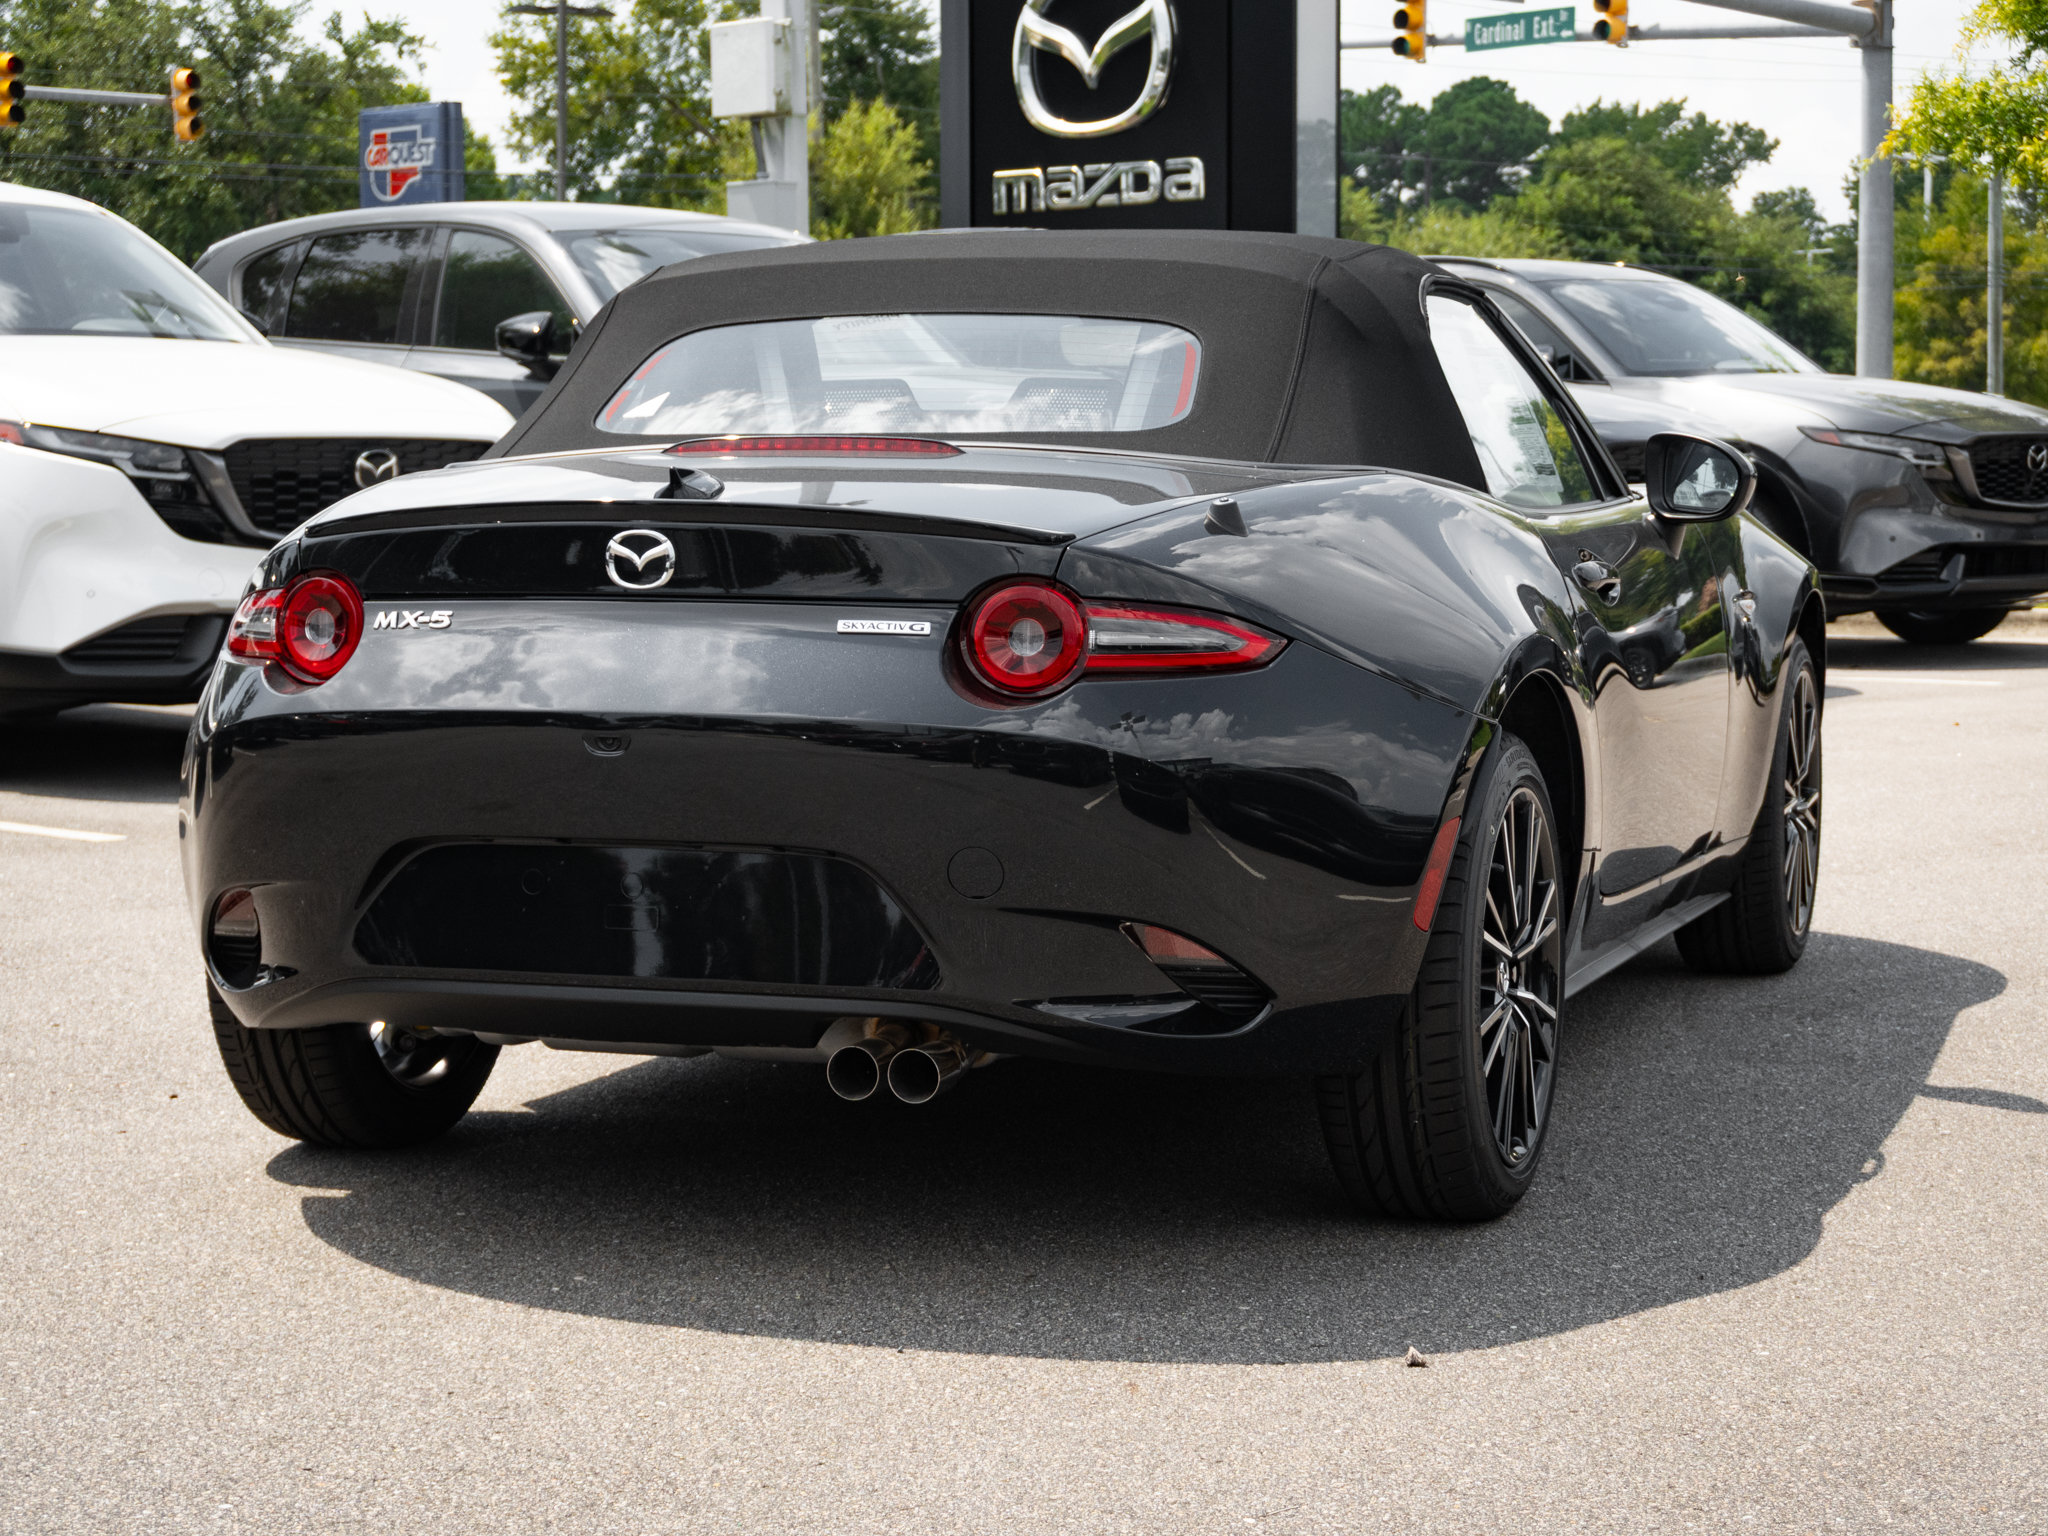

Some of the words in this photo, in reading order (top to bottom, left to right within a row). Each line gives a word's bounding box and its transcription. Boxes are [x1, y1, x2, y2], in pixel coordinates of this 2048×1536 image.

[1473, 18, 1525, 46] Cardinal
[367, 142, 434, 167] CARQUEST
[372, 610, 454, 630] MX-5
